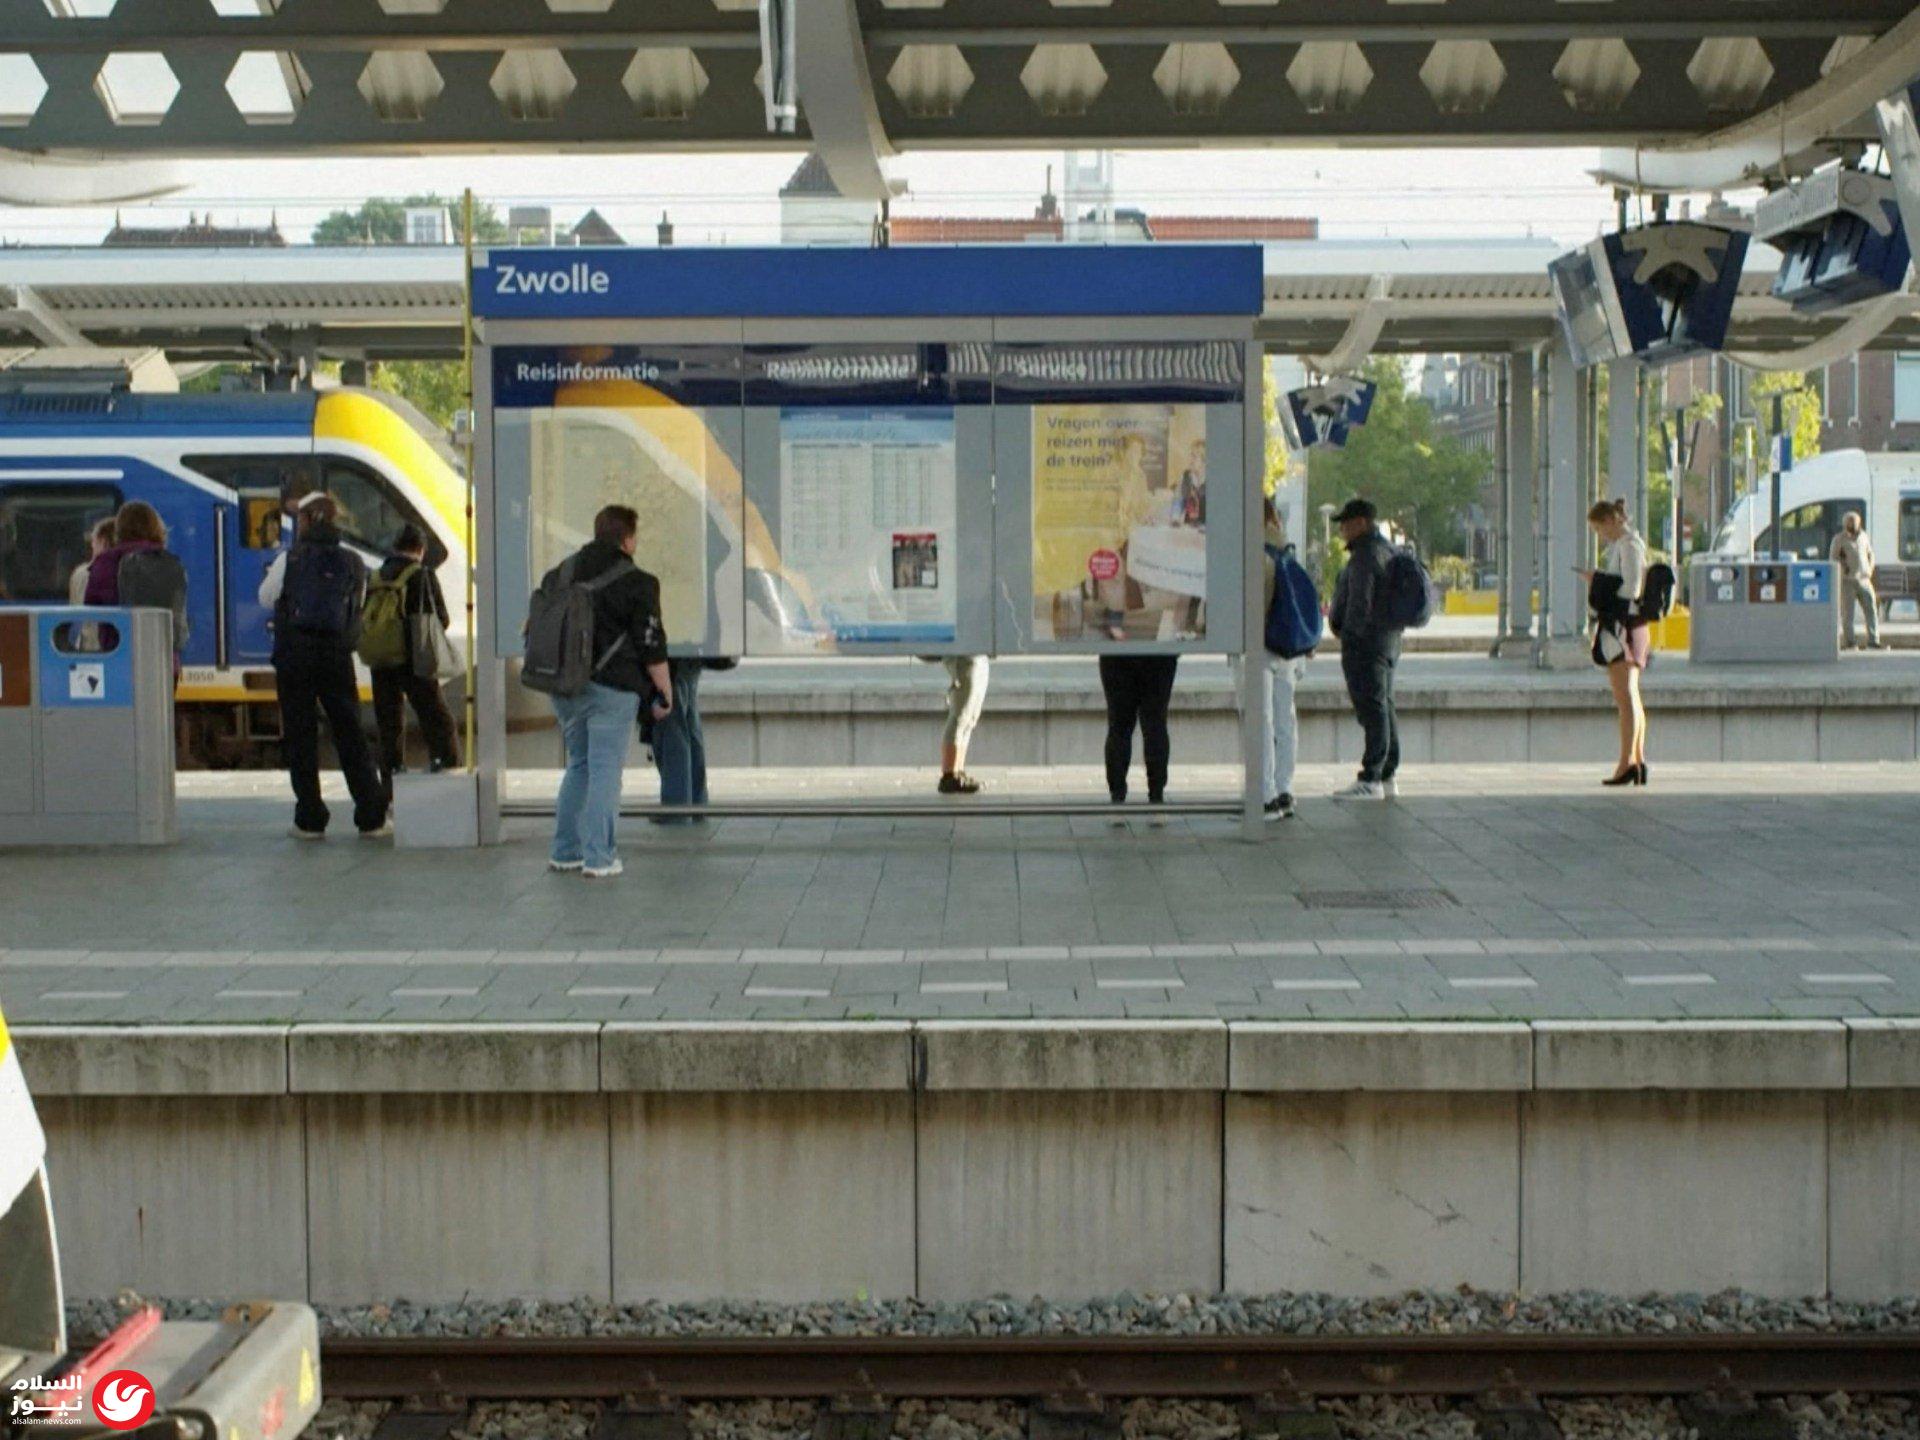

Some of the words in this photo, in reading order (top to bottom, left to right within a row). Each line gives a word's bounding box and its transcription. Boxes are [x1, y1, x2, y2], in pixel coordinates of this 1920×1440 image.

[496, 263, 609, 294] Zwolle
[517, 361, 659, 381] Reisinformatie
[1047, 416, 1100, 431] Vragen
[1047, 435, 1092, 448] reizen
[1047, 454, 1065, 467] de
